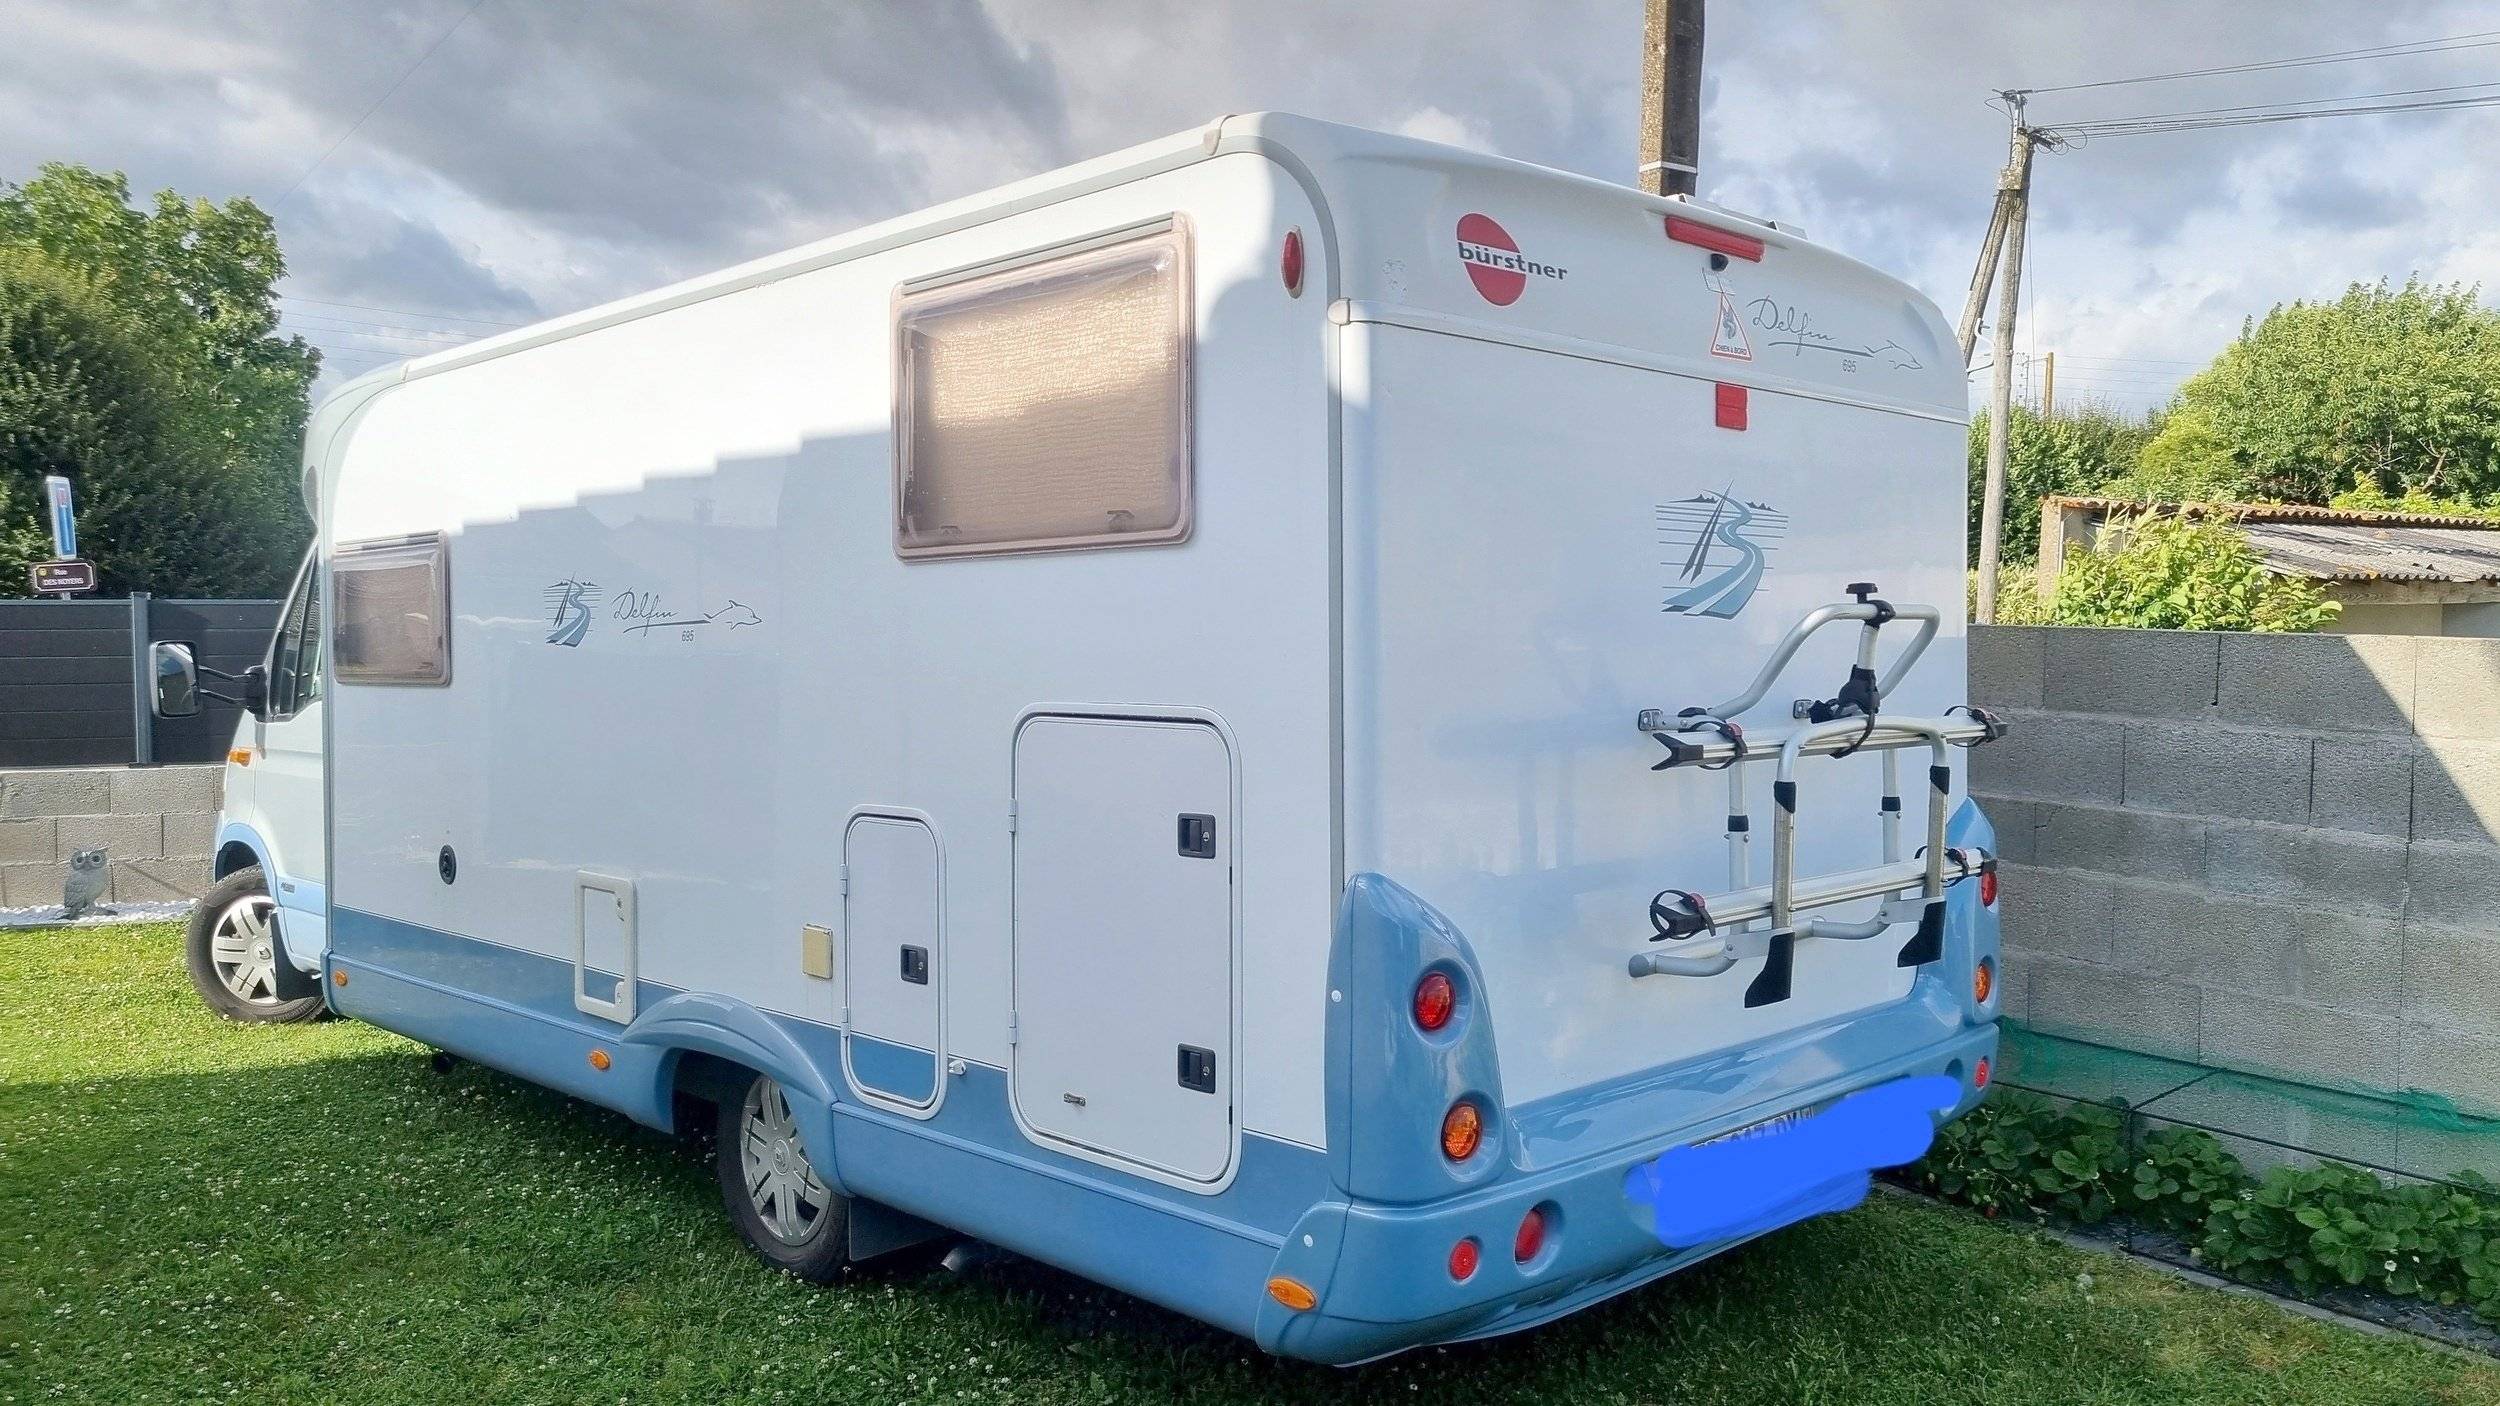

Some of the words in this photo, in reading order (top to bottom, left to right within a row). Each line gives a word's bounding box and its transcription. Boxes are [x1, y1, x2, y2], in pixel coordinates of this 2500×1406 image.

[1458, 242, 1568, 280] bürstner
[1746, 292, 1838, 357] Delfin
[1842, 359, 1857, 373] 695
[612, 585, 678, 638] Delfin
[681, 630, 695, 642] 695
